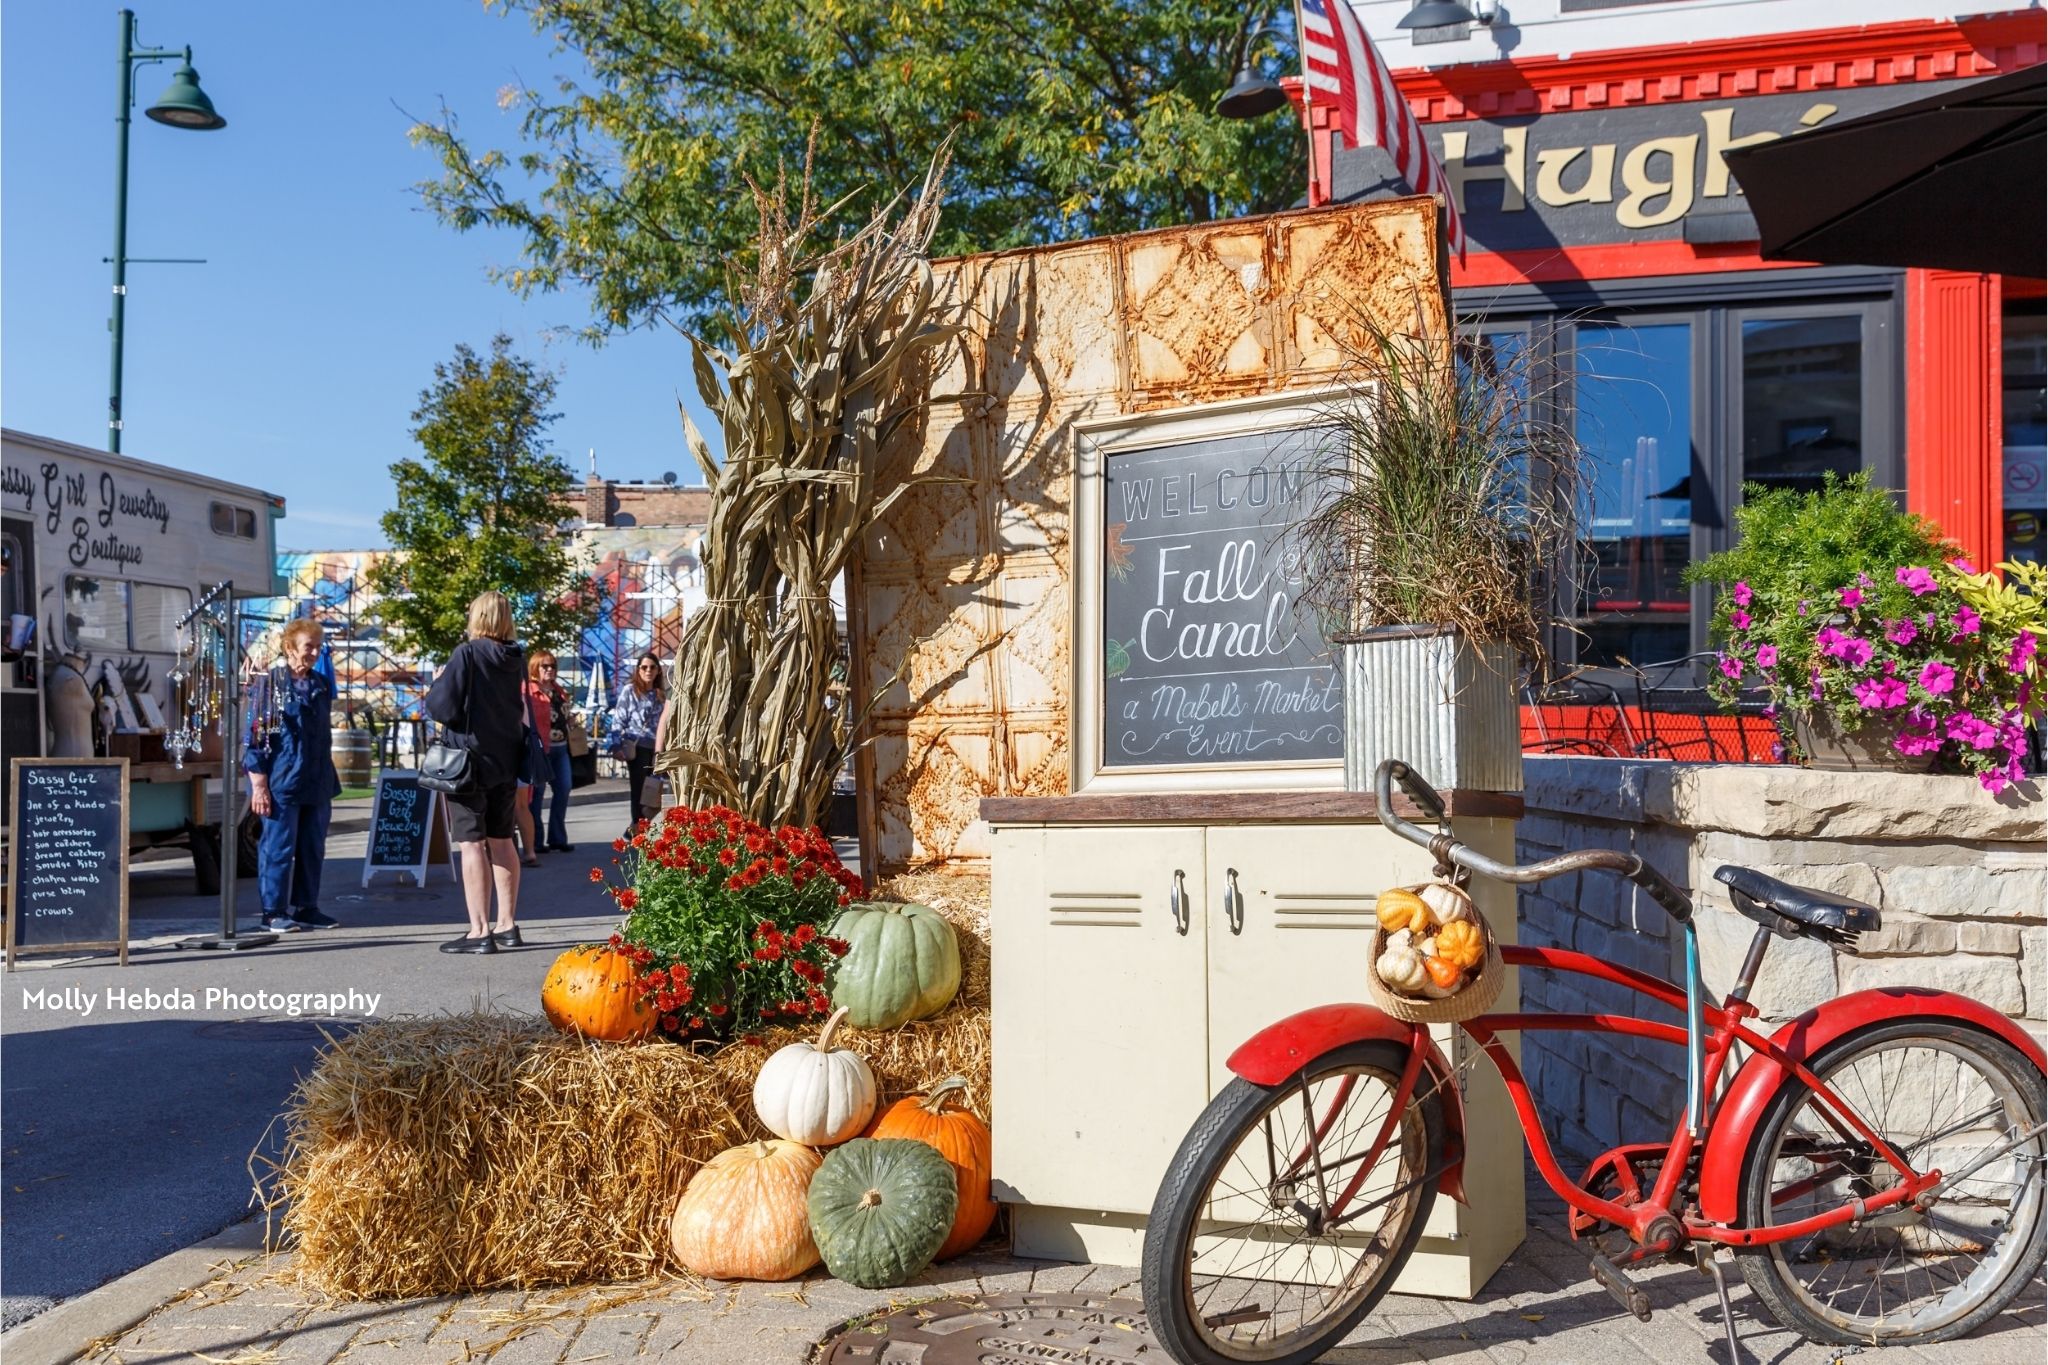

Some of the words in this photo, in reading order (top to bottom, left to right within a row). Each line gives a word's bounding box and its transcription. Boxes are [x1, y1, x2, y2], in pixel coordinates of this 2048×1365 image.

[40, 462, 87, 535] Girl
[98, 472, 169, 534] Jewelry
[68, 517, 143, 574] Boutique
[1157, 540, 1270, 606] Fall
[1140, 591, 1297, 662] Canal
[1123, 699, 1140, 720] a
[1151, 682, 1249, 724] Mabel's
[1255, 672, 1343, 715] Market
[1186, 720, 1267, 756] Event
[27, 770, 65, 787] Sassy
[382, 782, 417, 807] Sassy
[47, 799, 60, 810] of
[32, 829, 50, 838] hair
[34, 841, 50, 849] sun
[54, 839, 92, 848] catchers
[34, 851, 62, 860] dream
[68, 849, 106, 860] catchers
[35, 861, 71, 871] smudge
[71, 873, 100, 884] wands
[32, 890, 56, 901] purse
[35, 907, 74, 917] crowns
